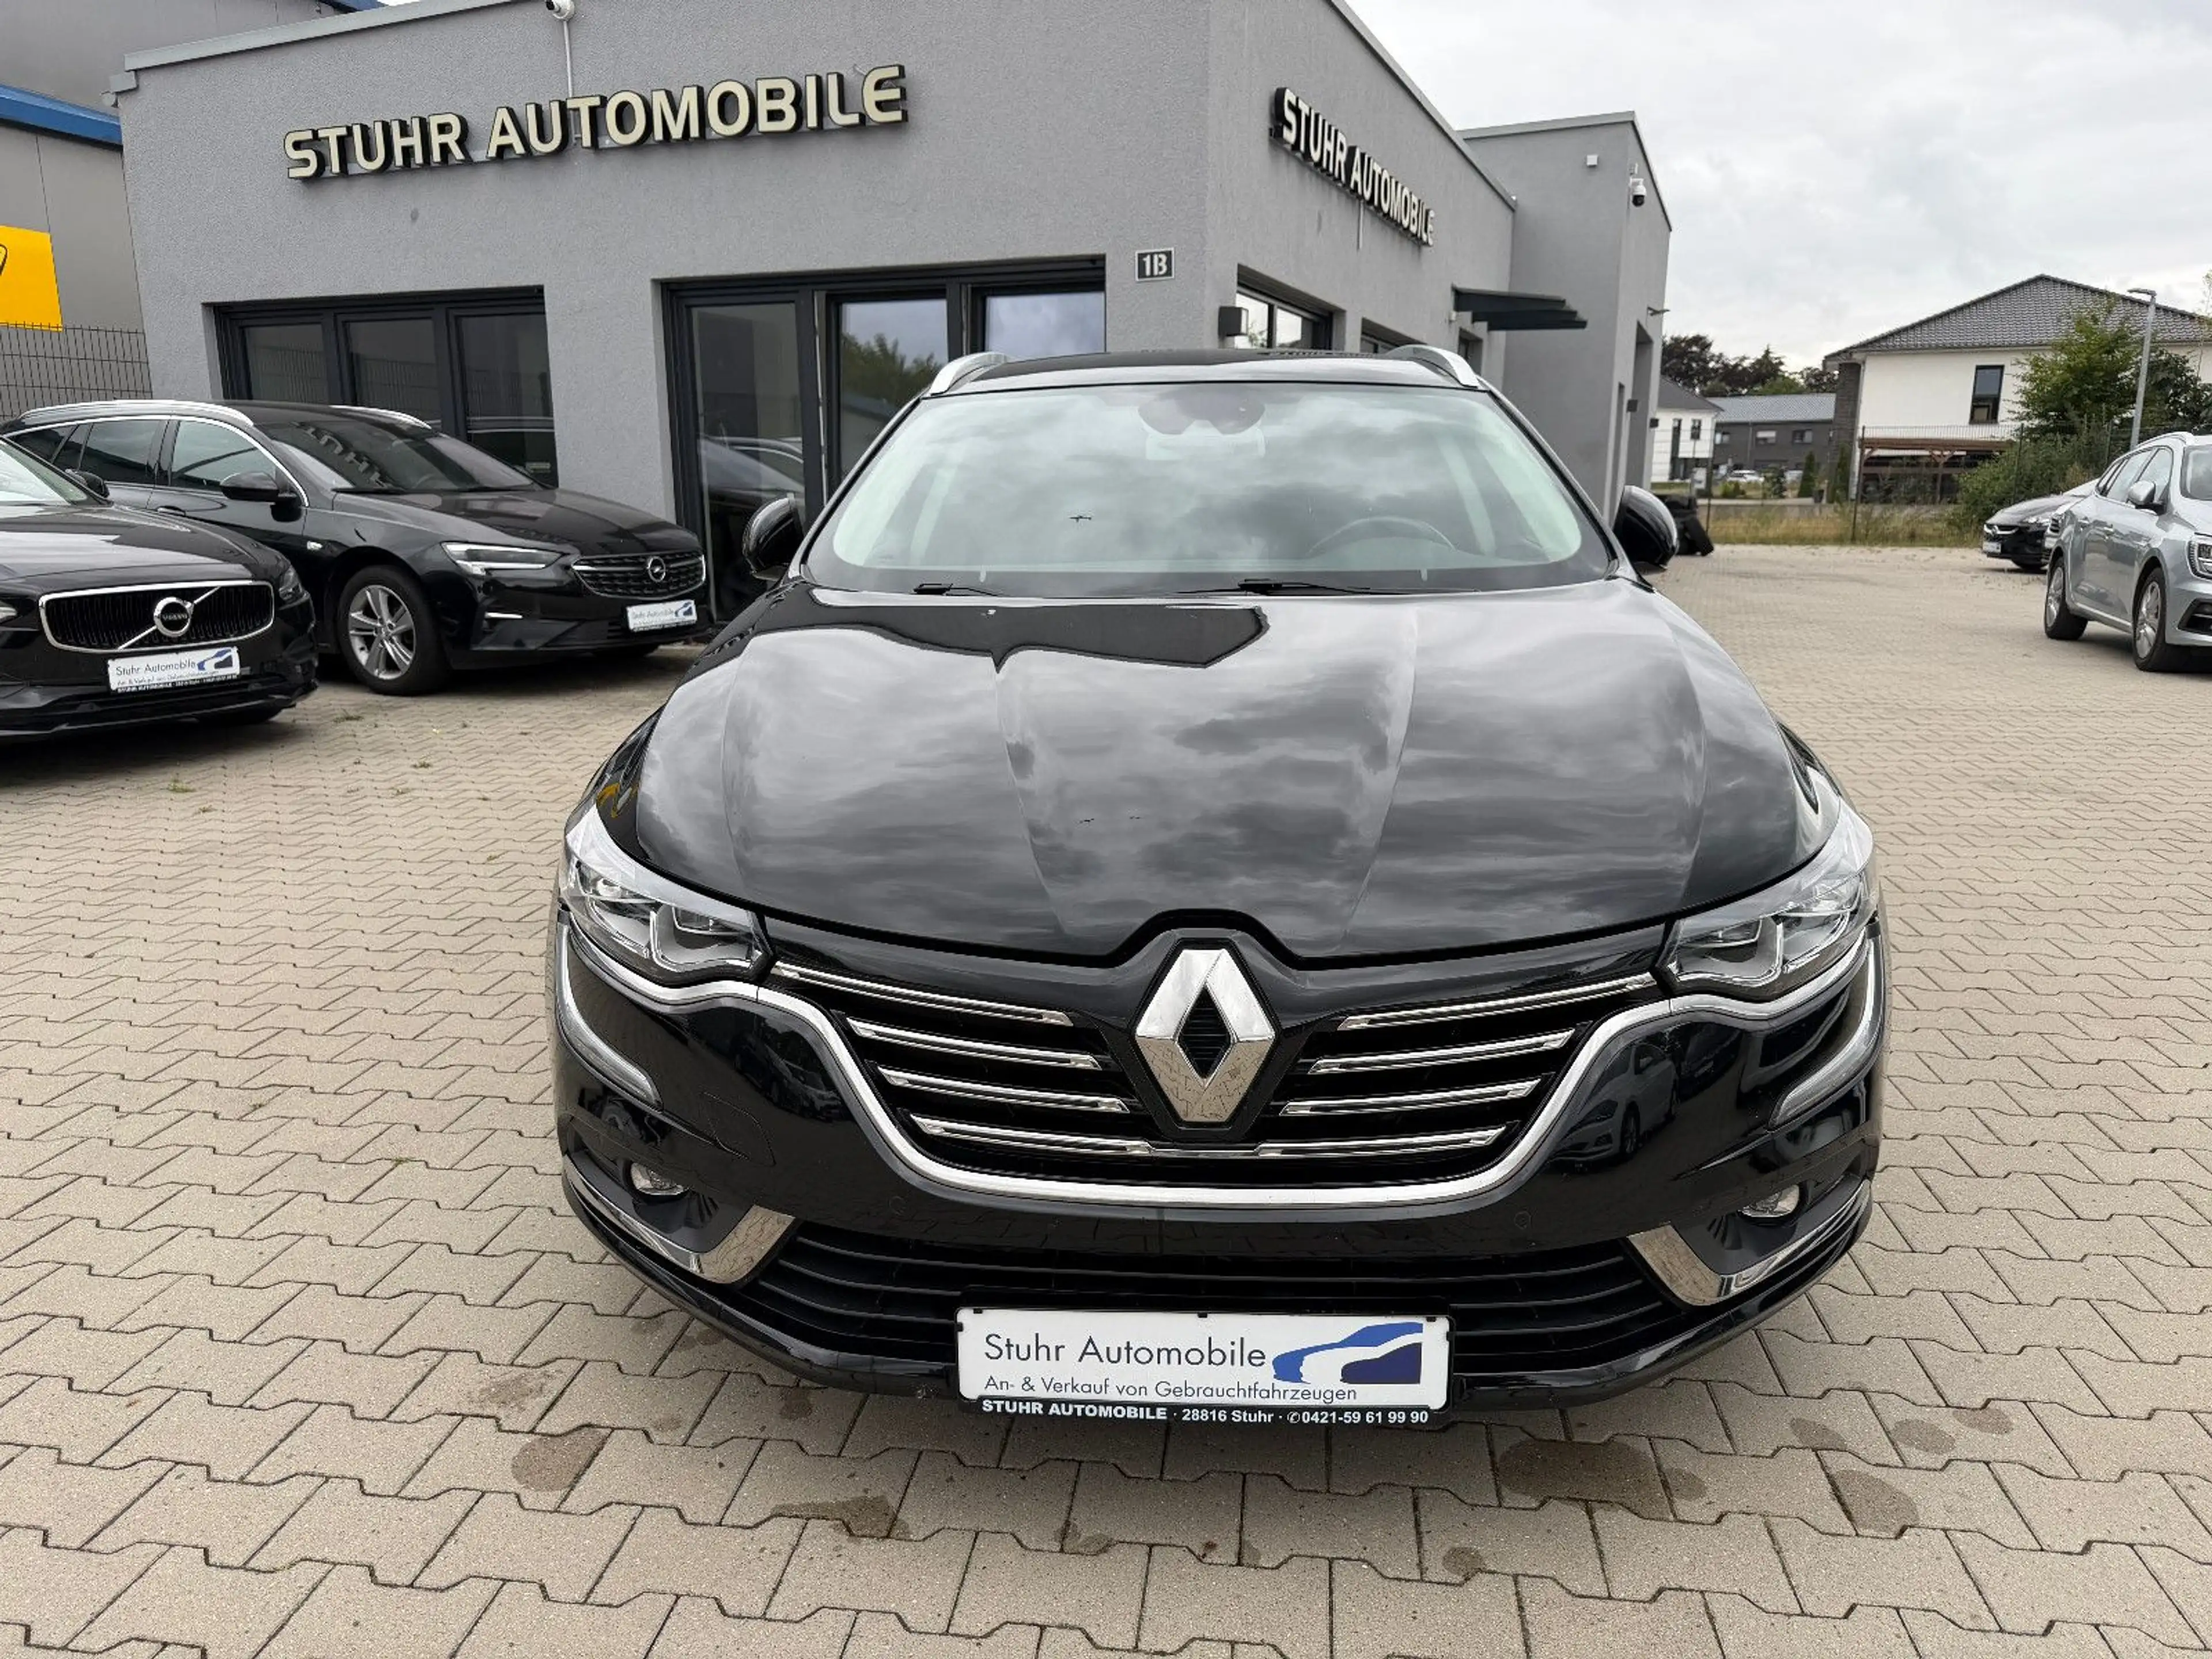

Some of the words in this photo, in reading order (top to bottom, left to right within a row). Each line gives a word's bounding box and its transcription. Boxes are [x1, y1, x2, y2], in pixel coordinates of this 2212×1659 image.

[283, 112, 465, 179] STUHR
[487, 65, 907, 159] AUTOMOBILE
[1275, 88, 1348, 183] STUHR
[1350, 146, 1435, 247] AUTOMOBILE
[1142, 253, 1168, 276] 1B
[984, 1332, 1066, 1362] Stuhr
[1078, 1335, 1266, 1367] Automobile
[984, 1376, 1014, 1391] An-
[1021, 1376, 1036, 1392] &
[1041, 1376, 1111, 1395] Verkauf
[1115, 1384, 1147, 1397] von
[1155, 1380, 1358, 1404] Gebrauchtfahrzeugen
[982, 1399, 1044, 1415] STUHR
[1048, 1403, 1168, 1421] AUTOMOBILE
[1181, 1408, 1228, 1423] 28816
[1231, 1410, 1274, 1423] Stuhr
[1365, 1411, 1382, 1424] 61
[1388, 1411, 1406, 1424] 99
[1410, 1411, 1429, 1424] 90
